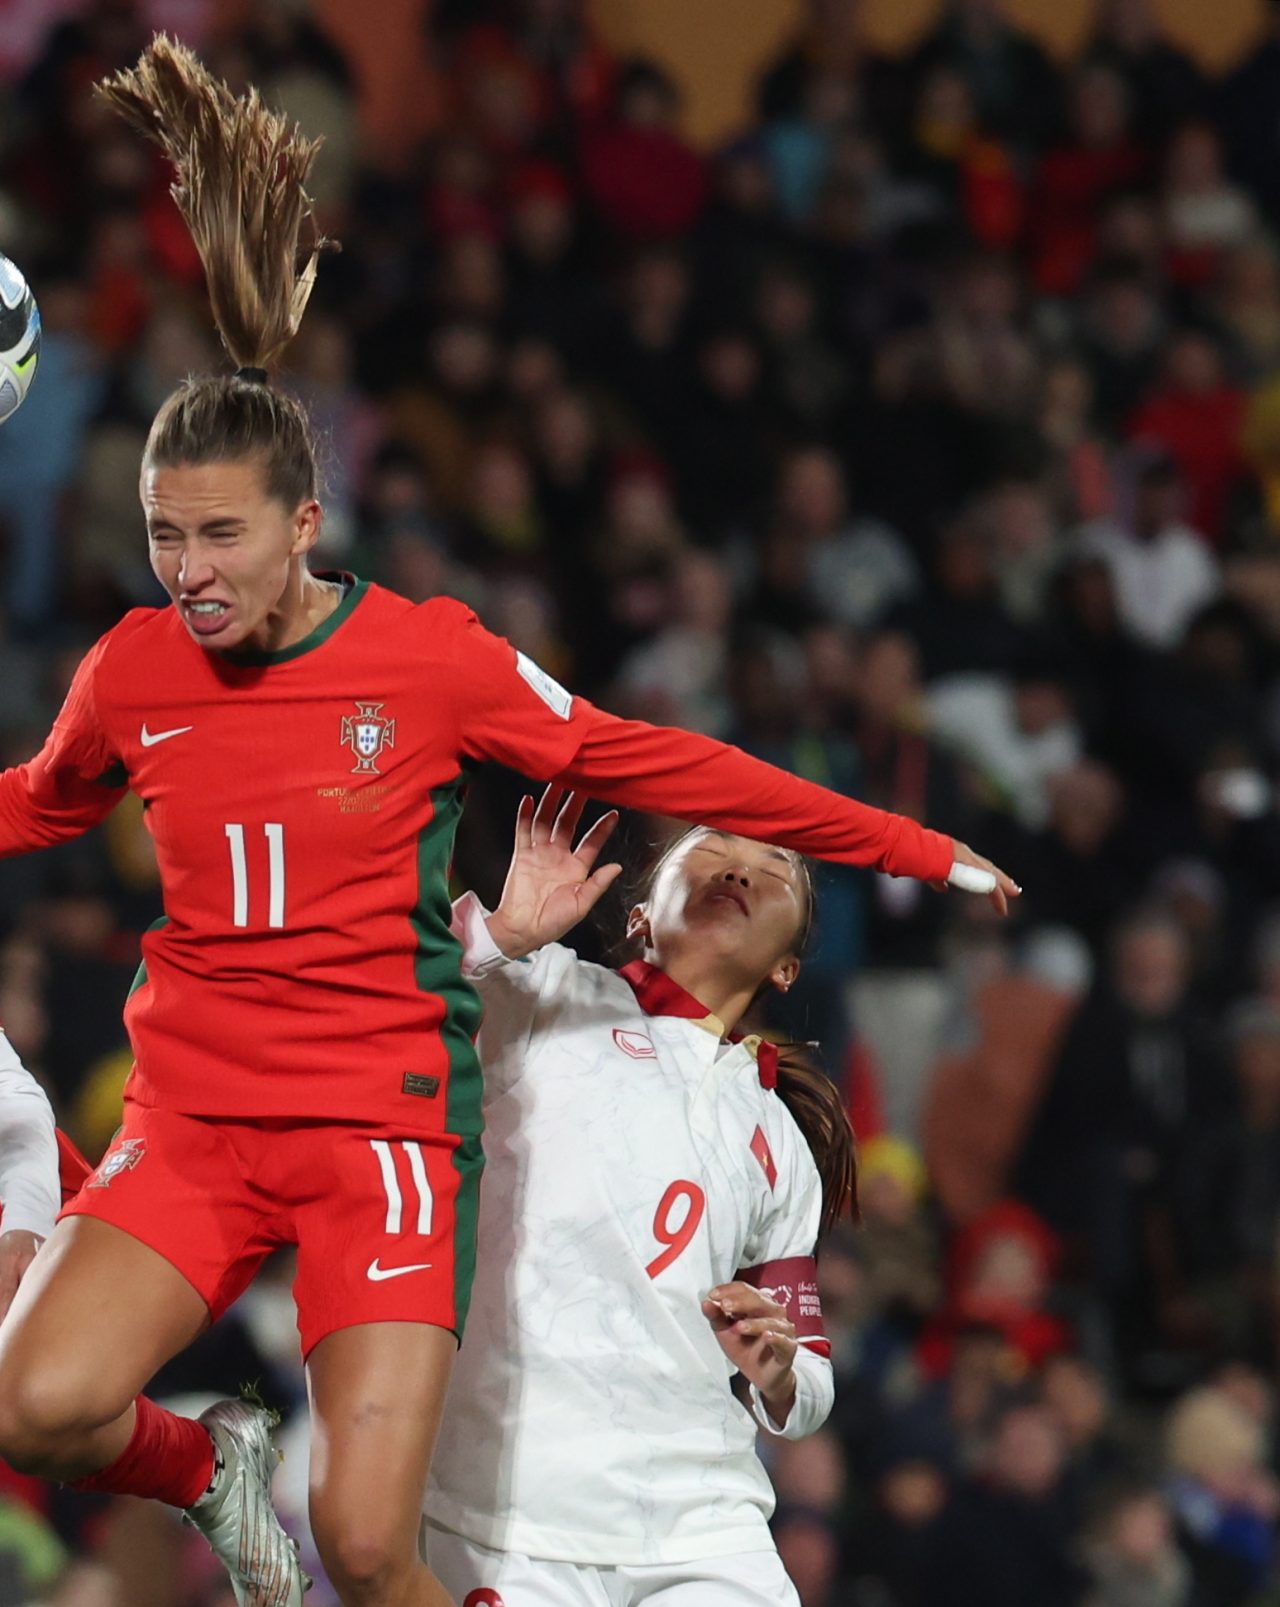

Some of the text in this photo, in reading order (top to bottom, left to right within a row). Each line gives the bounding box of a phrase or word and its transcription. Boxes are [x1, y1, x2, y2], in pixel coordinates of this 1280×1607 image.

[225, 823, 284, 927] 11
[370, 1140, 433, 1234] 11
[645, 1179, 705, 1280] 9
